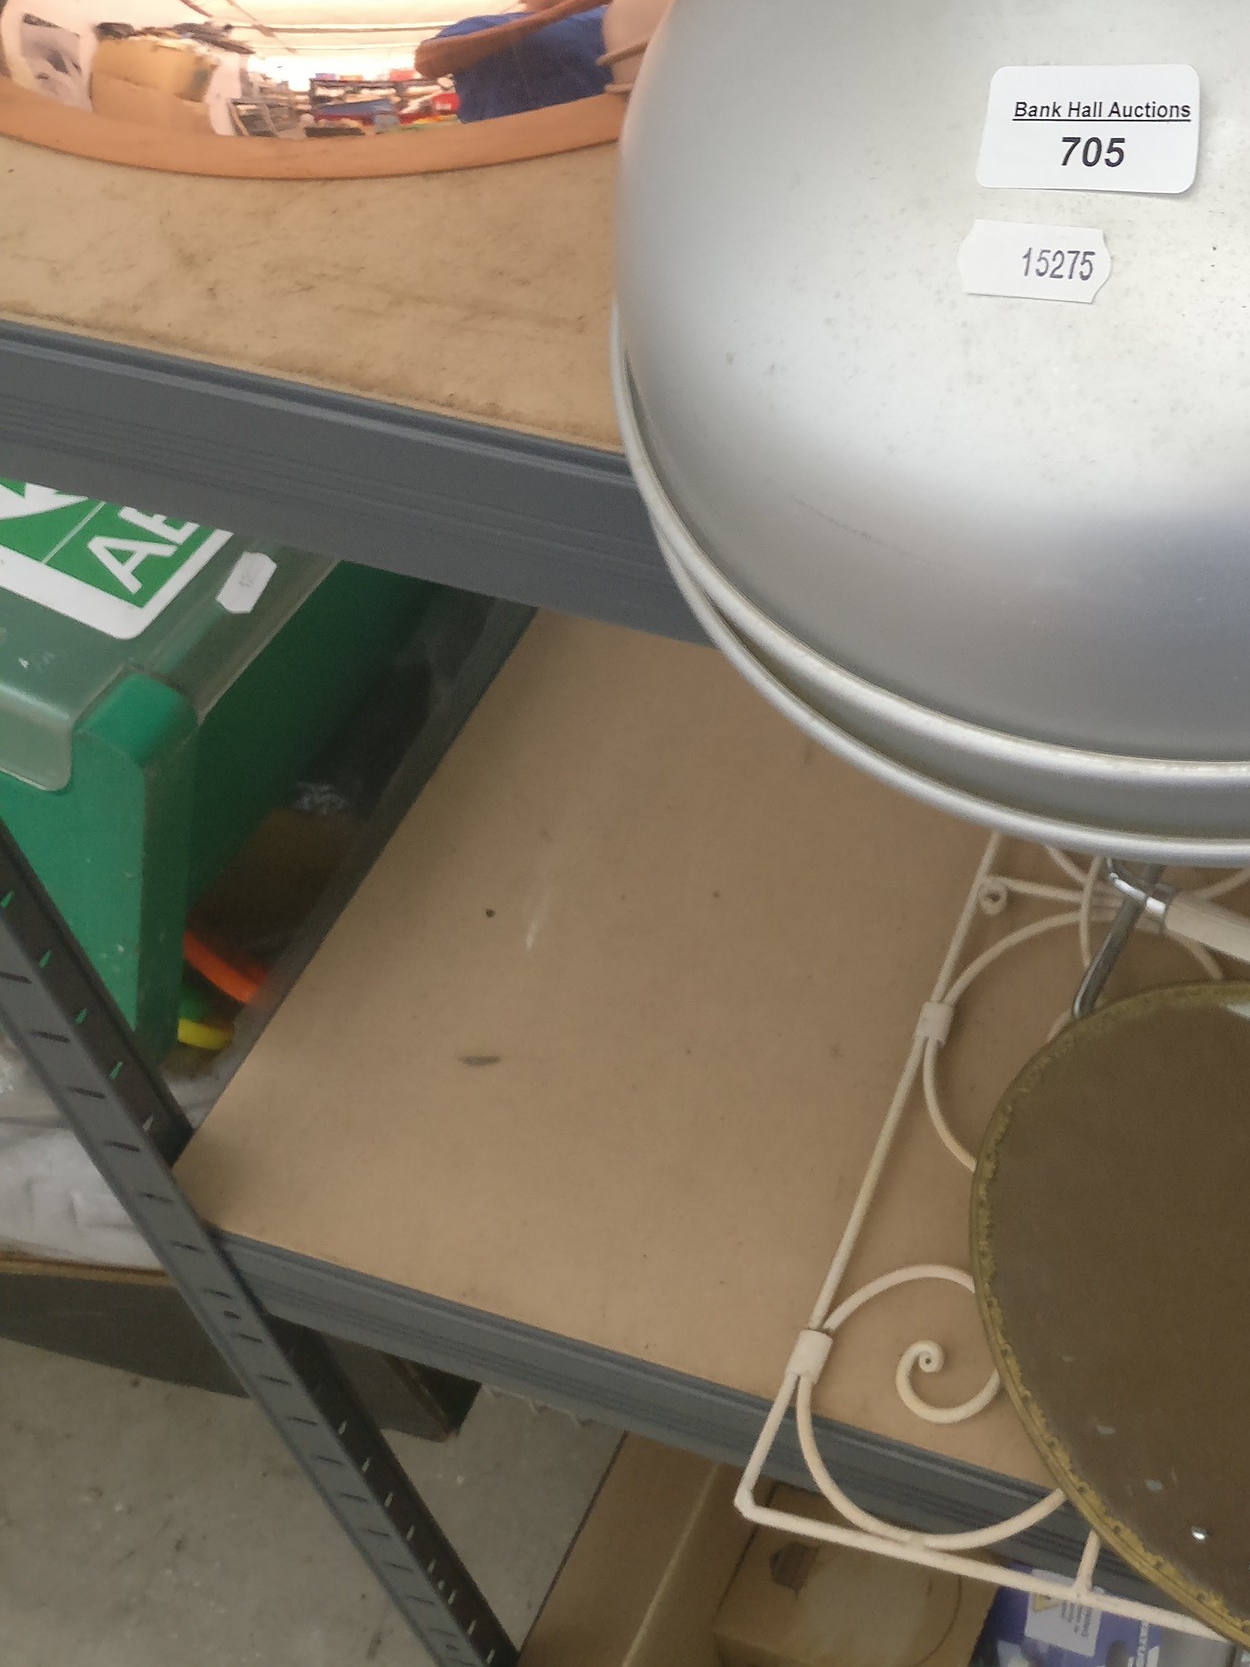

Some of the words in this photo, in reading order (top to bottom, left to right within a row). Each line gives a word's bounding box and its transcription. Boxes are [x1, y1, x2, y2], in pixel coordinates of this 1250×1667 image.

[1013, 101, 1062, 118] Bank
[1067, 101, 1102, 118] Hall
[1107, 101, 1191, 119] Auctions
[1060, 136, 1126, 168] 705
[1021, 246, 1096, 281] 15275
